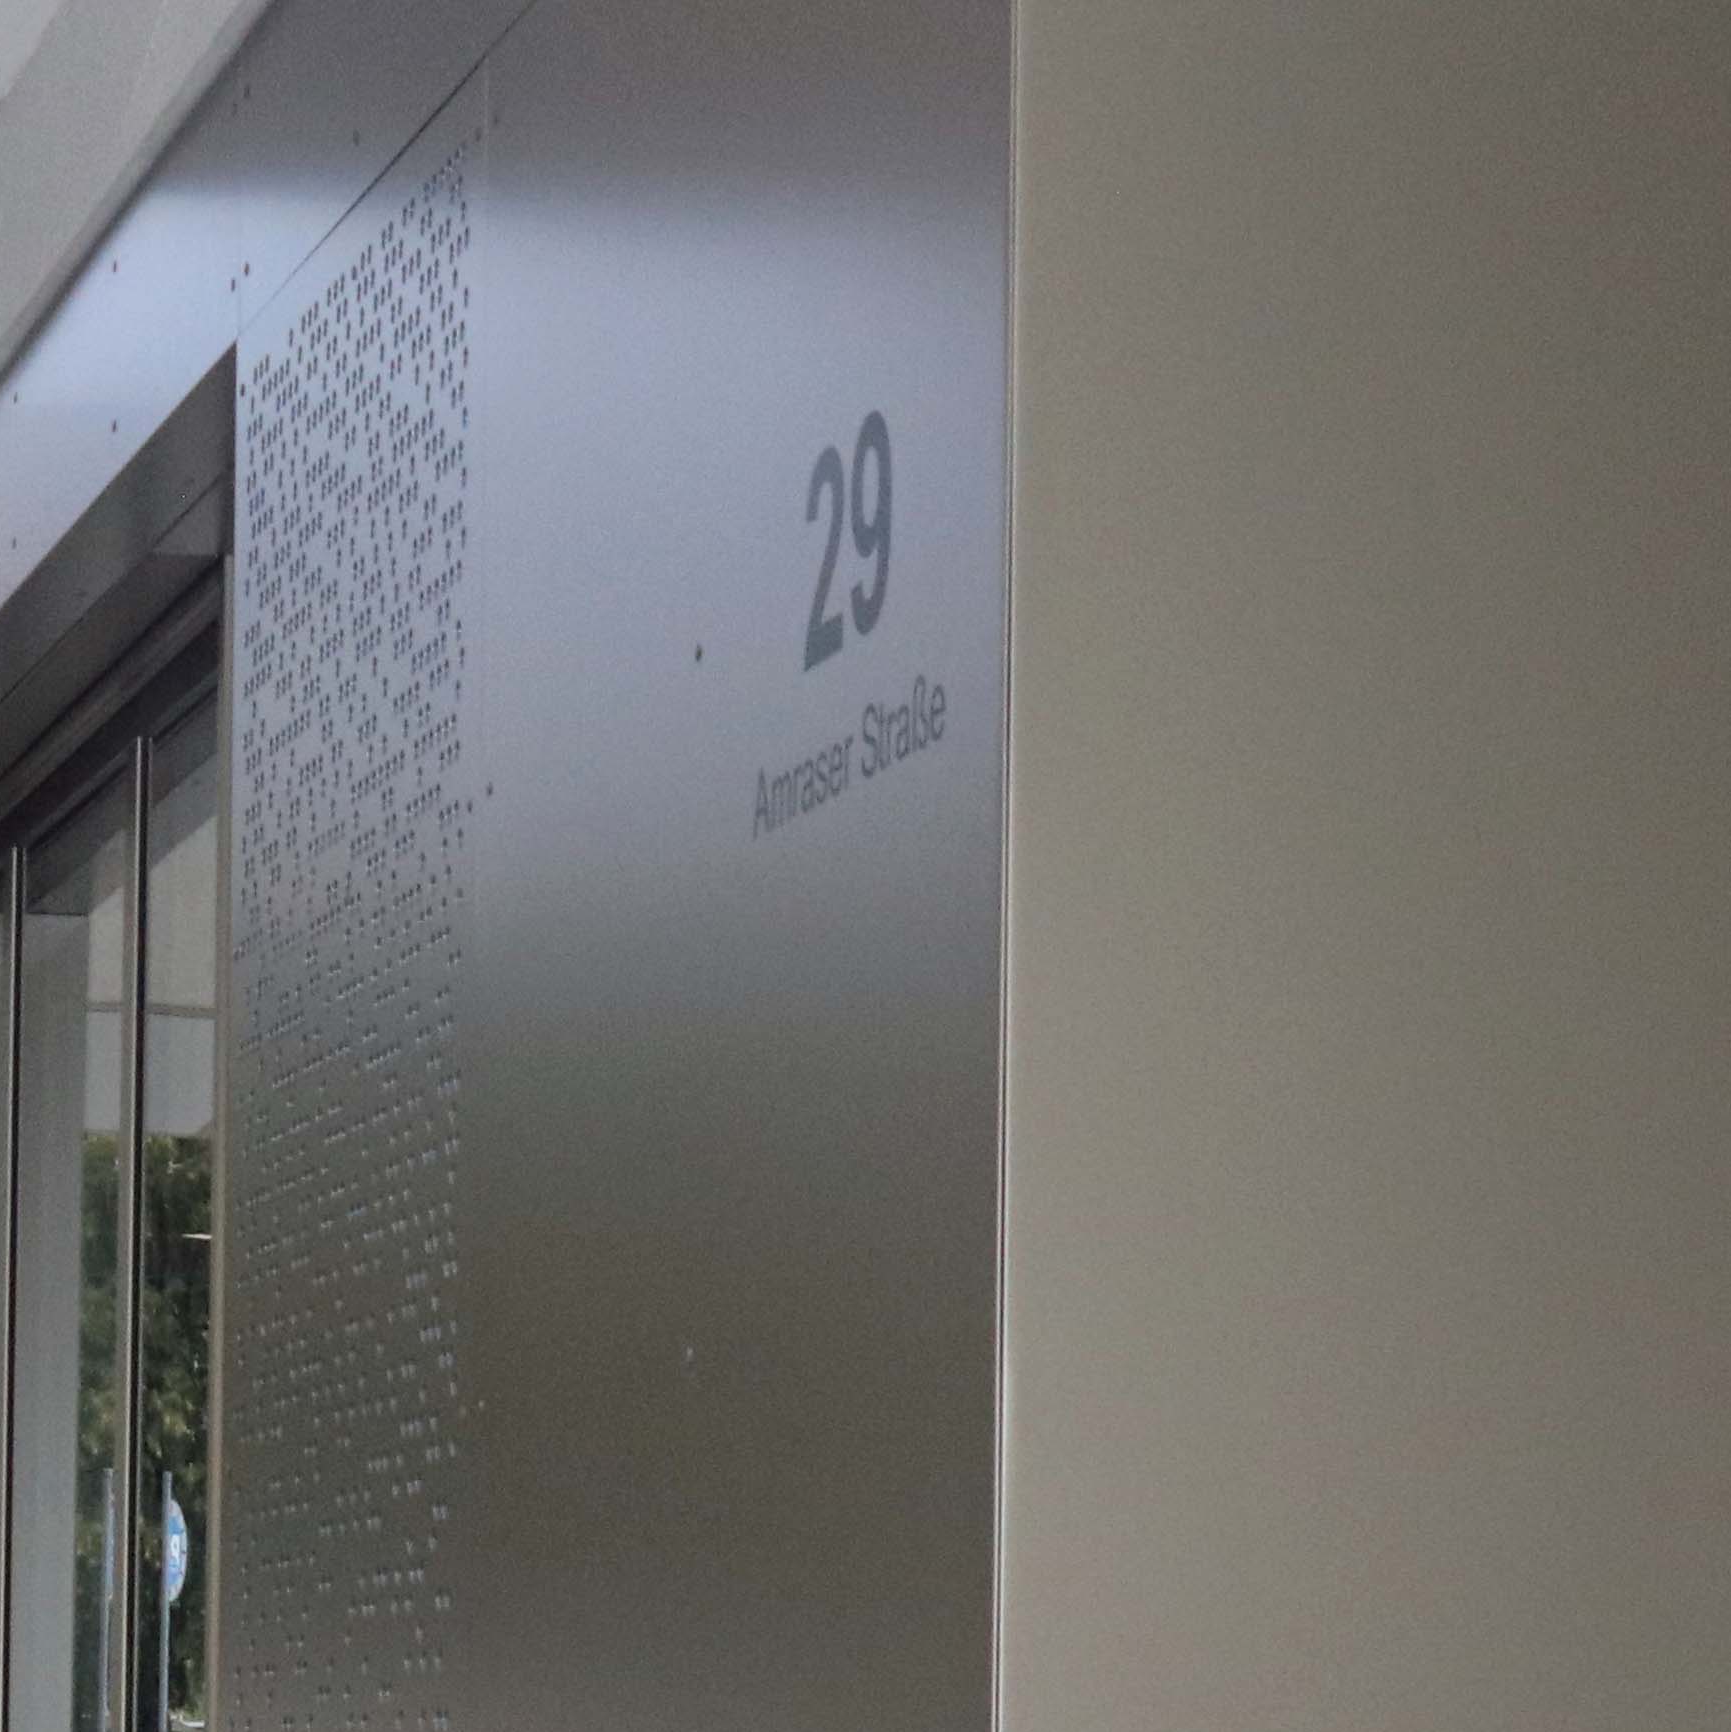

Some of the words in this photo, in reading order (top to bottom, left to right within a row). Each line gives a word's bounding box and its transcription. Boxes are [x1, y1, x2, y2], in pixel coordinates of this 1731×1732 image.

[803, 410, 893, 672] 29
[751, 730, 854, 841] Amraser
[861, 673, 947, 780] Straße
